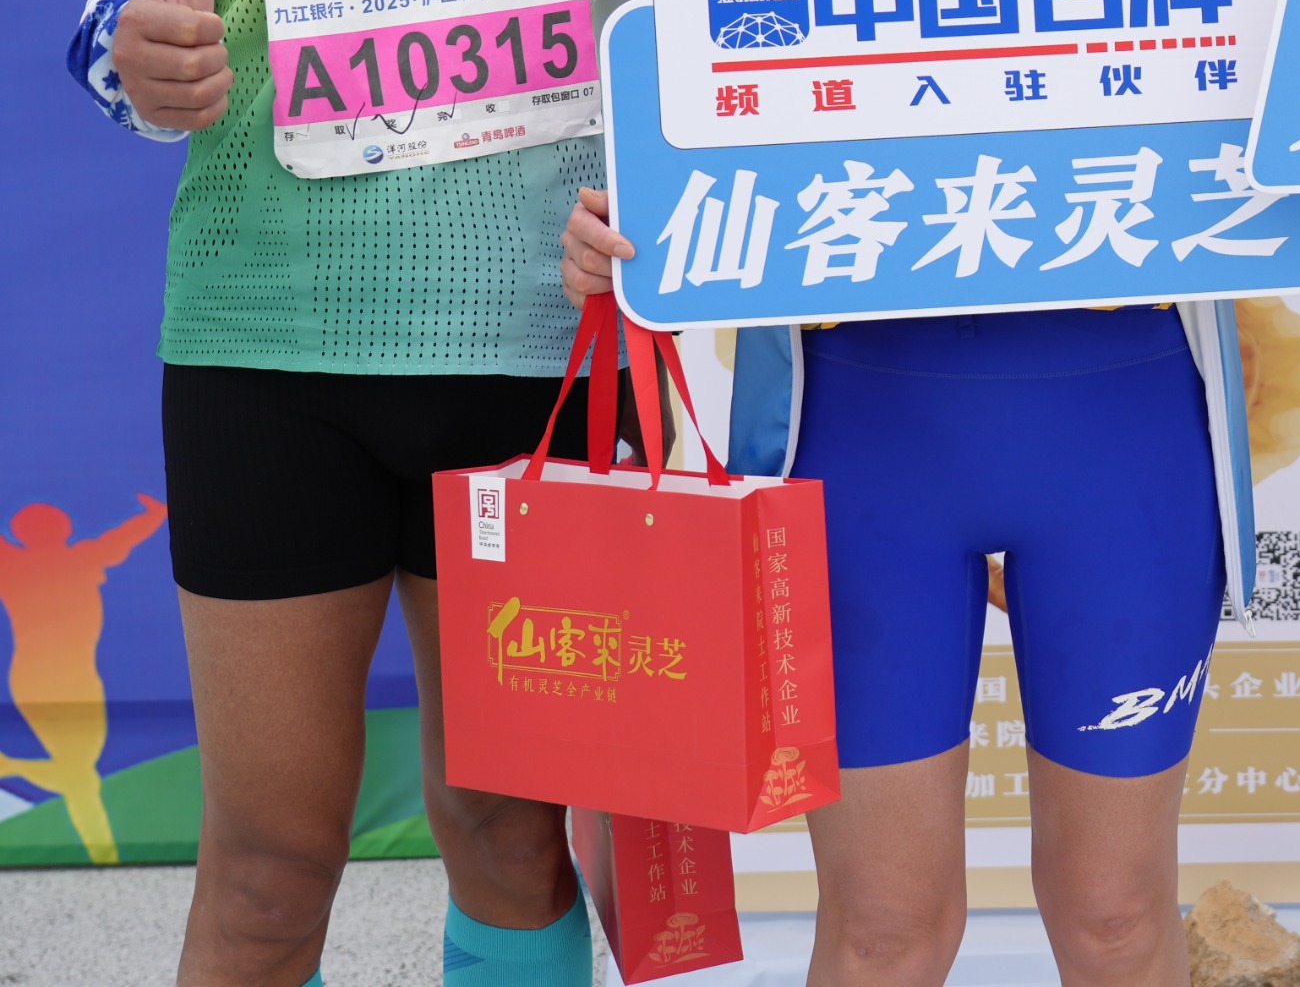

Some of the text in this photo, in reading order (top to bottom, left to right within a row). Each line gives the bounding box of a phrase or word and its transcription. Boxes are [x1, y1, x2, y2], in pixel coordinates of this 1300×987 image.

[287, 10, 579, 117] A10315
[532, 86, 595, 106] 存取包窗口 07
[715, 59, 1238, 117] 频道入驻伙伴
[486, 103, 496, 113] 收
[481, 125, 526, 143] 青岛啤酒
[386, 140, 428, 154] 洋河股份
[388, 150, 430, 160] YANGHE
[656, 142, 1293, 295] 仙客来灵芝
[478, 521, 494, 530] China
[766, 526, 801, 726] 国家高新技术企业
[508, 675, 618, 704] 有机灵芝全产业链
